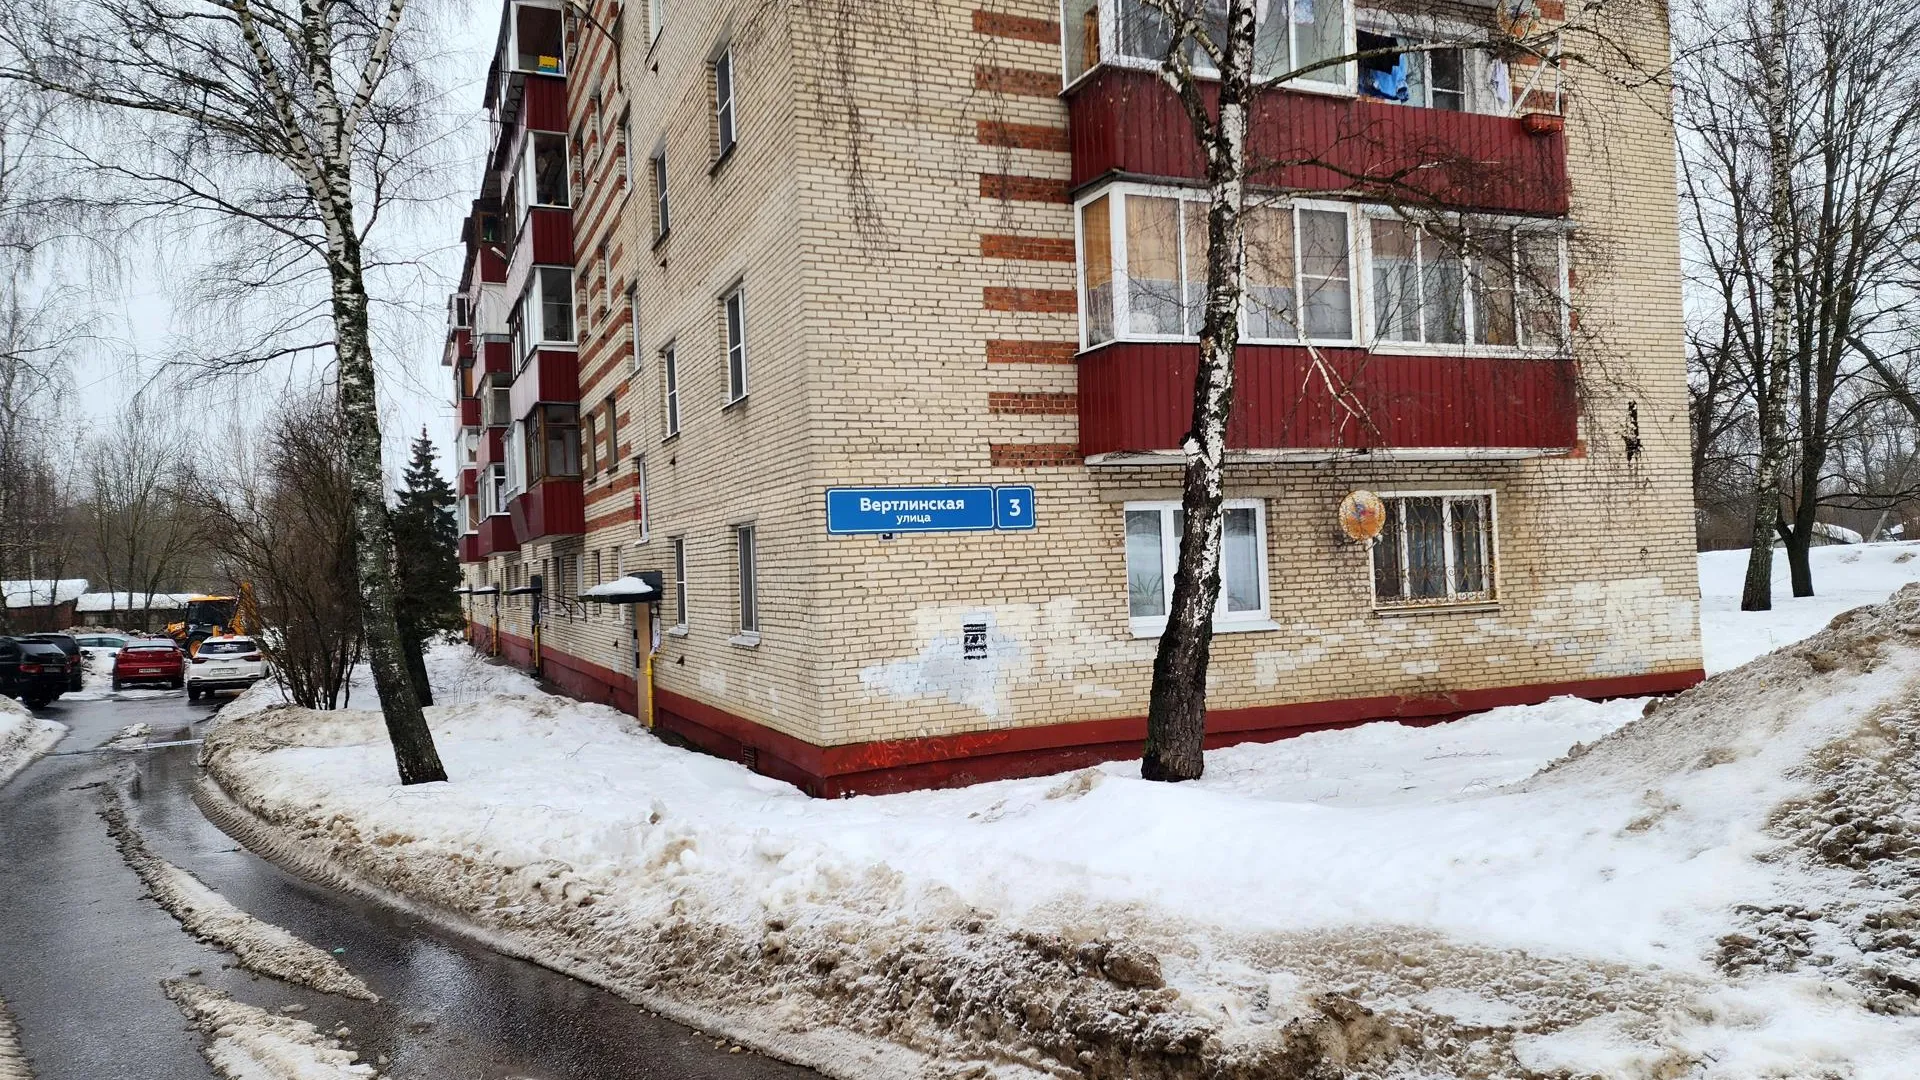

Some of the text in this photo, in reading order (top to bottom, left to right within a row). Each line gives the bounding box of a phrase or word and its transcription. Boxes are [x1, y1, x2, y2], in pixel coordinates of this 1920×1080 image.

[860, 498, 965, 514] Вертлинская
[1009, 499, 1021, 517] 3
[896, 514, 931, 525] улица
